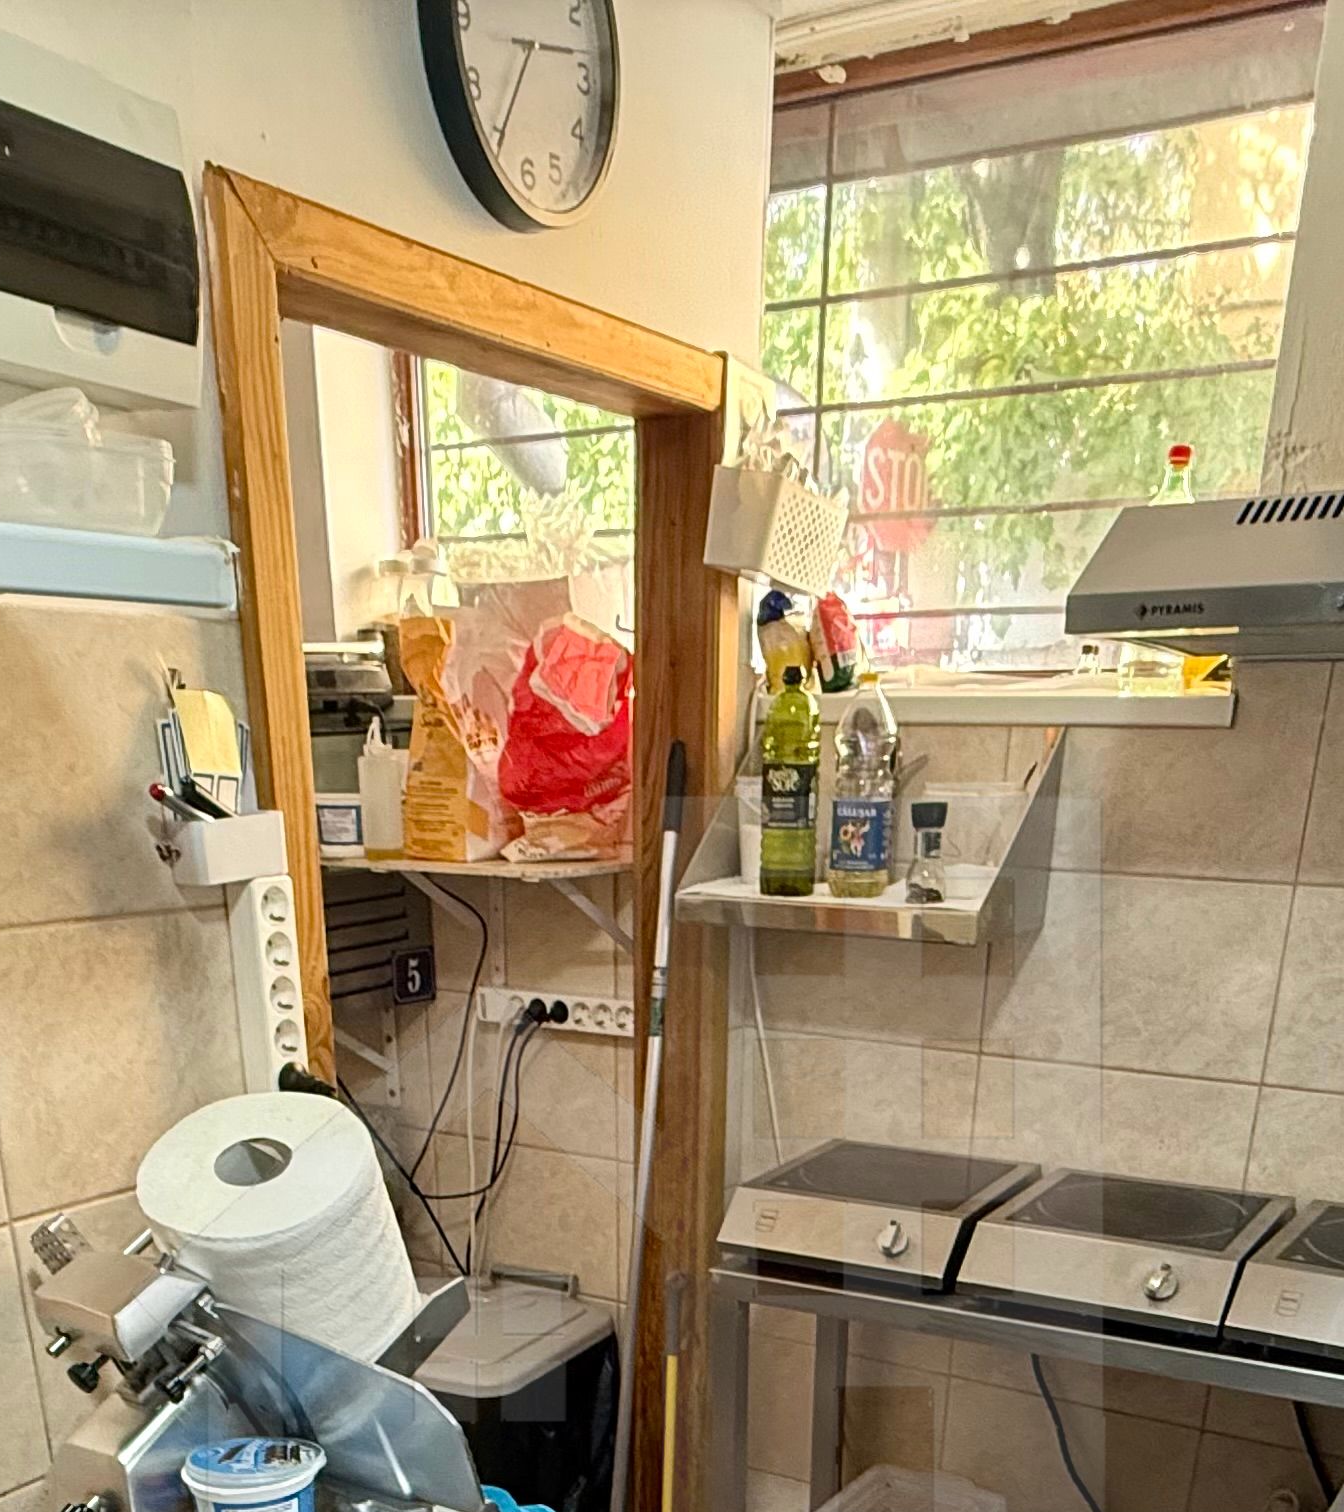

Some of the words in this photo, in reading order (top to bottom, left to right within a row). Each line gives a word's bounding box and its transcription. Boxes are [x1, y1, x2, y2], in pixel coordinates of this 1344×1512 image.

[467, 66, 482, 101] 8
[576, 62, 591, 96] 3
[570, 115, 585, 150] 4
[520, 157, 537, 191] 6
[548, 152, 563, 186] 5
[1150, 602, 1205, 617] PYRAMIS
[407, 957, 421, 993] 5
